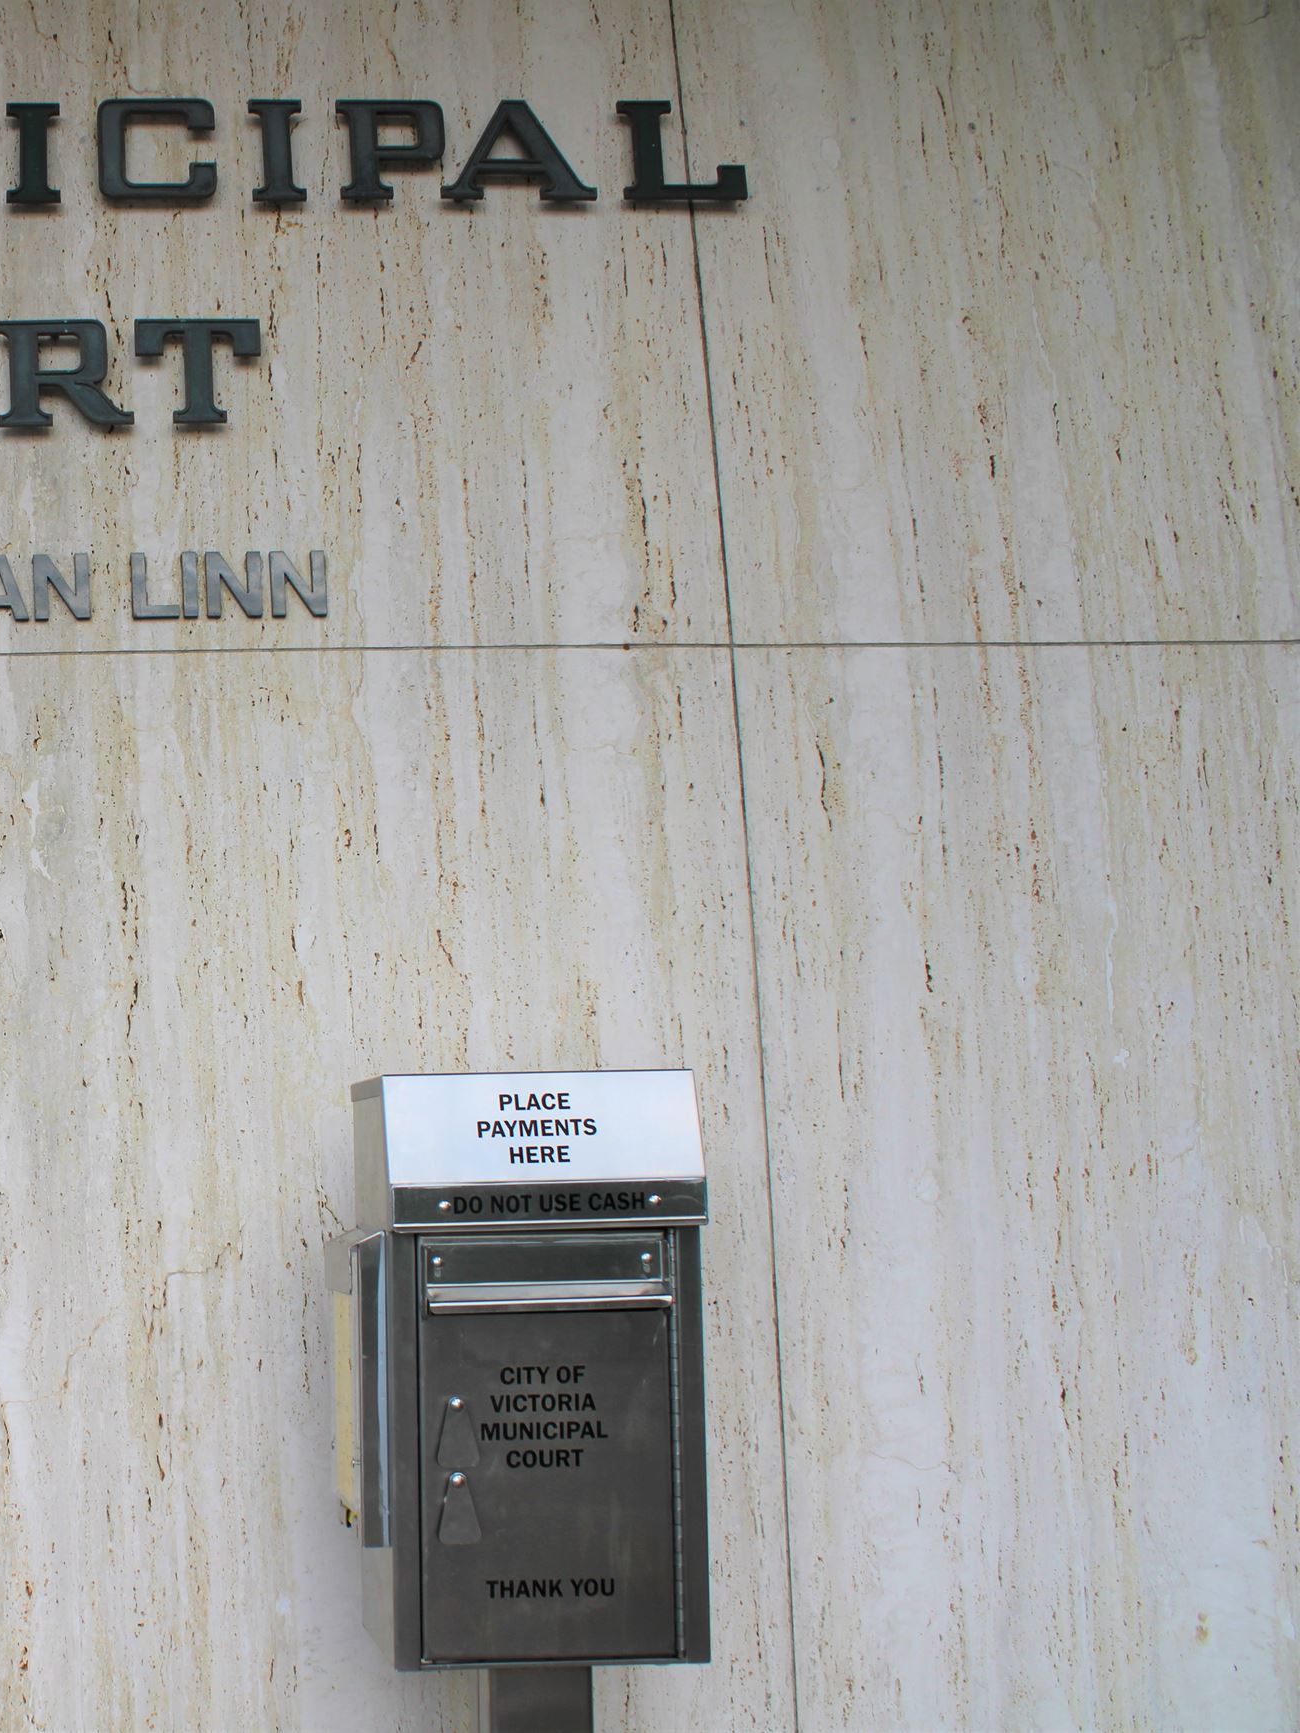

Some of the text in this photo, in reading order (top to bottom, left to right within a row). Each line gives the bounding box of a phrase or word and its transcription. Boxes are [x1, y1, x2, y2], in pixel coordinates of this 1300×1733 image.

[130, 550, 328, 620] LINN
[498, 1093, 571, 1111] PLACE
[477, 1118, 598, 1138] PAYMENTS
[509, 1145, 571, 1164] HERE
[453, 1192, 646, 1214] DO NOT USE CASH
[501, 1365, 586, 1385] CITY OF
[490, 1393, 596, 1413] VICTORIA
[481, 1421, 608, 1441] MUNICIPAL
[506, 1449, 584, 1468] COURT
[486, 1578, 615, 1599] THANK YOU
